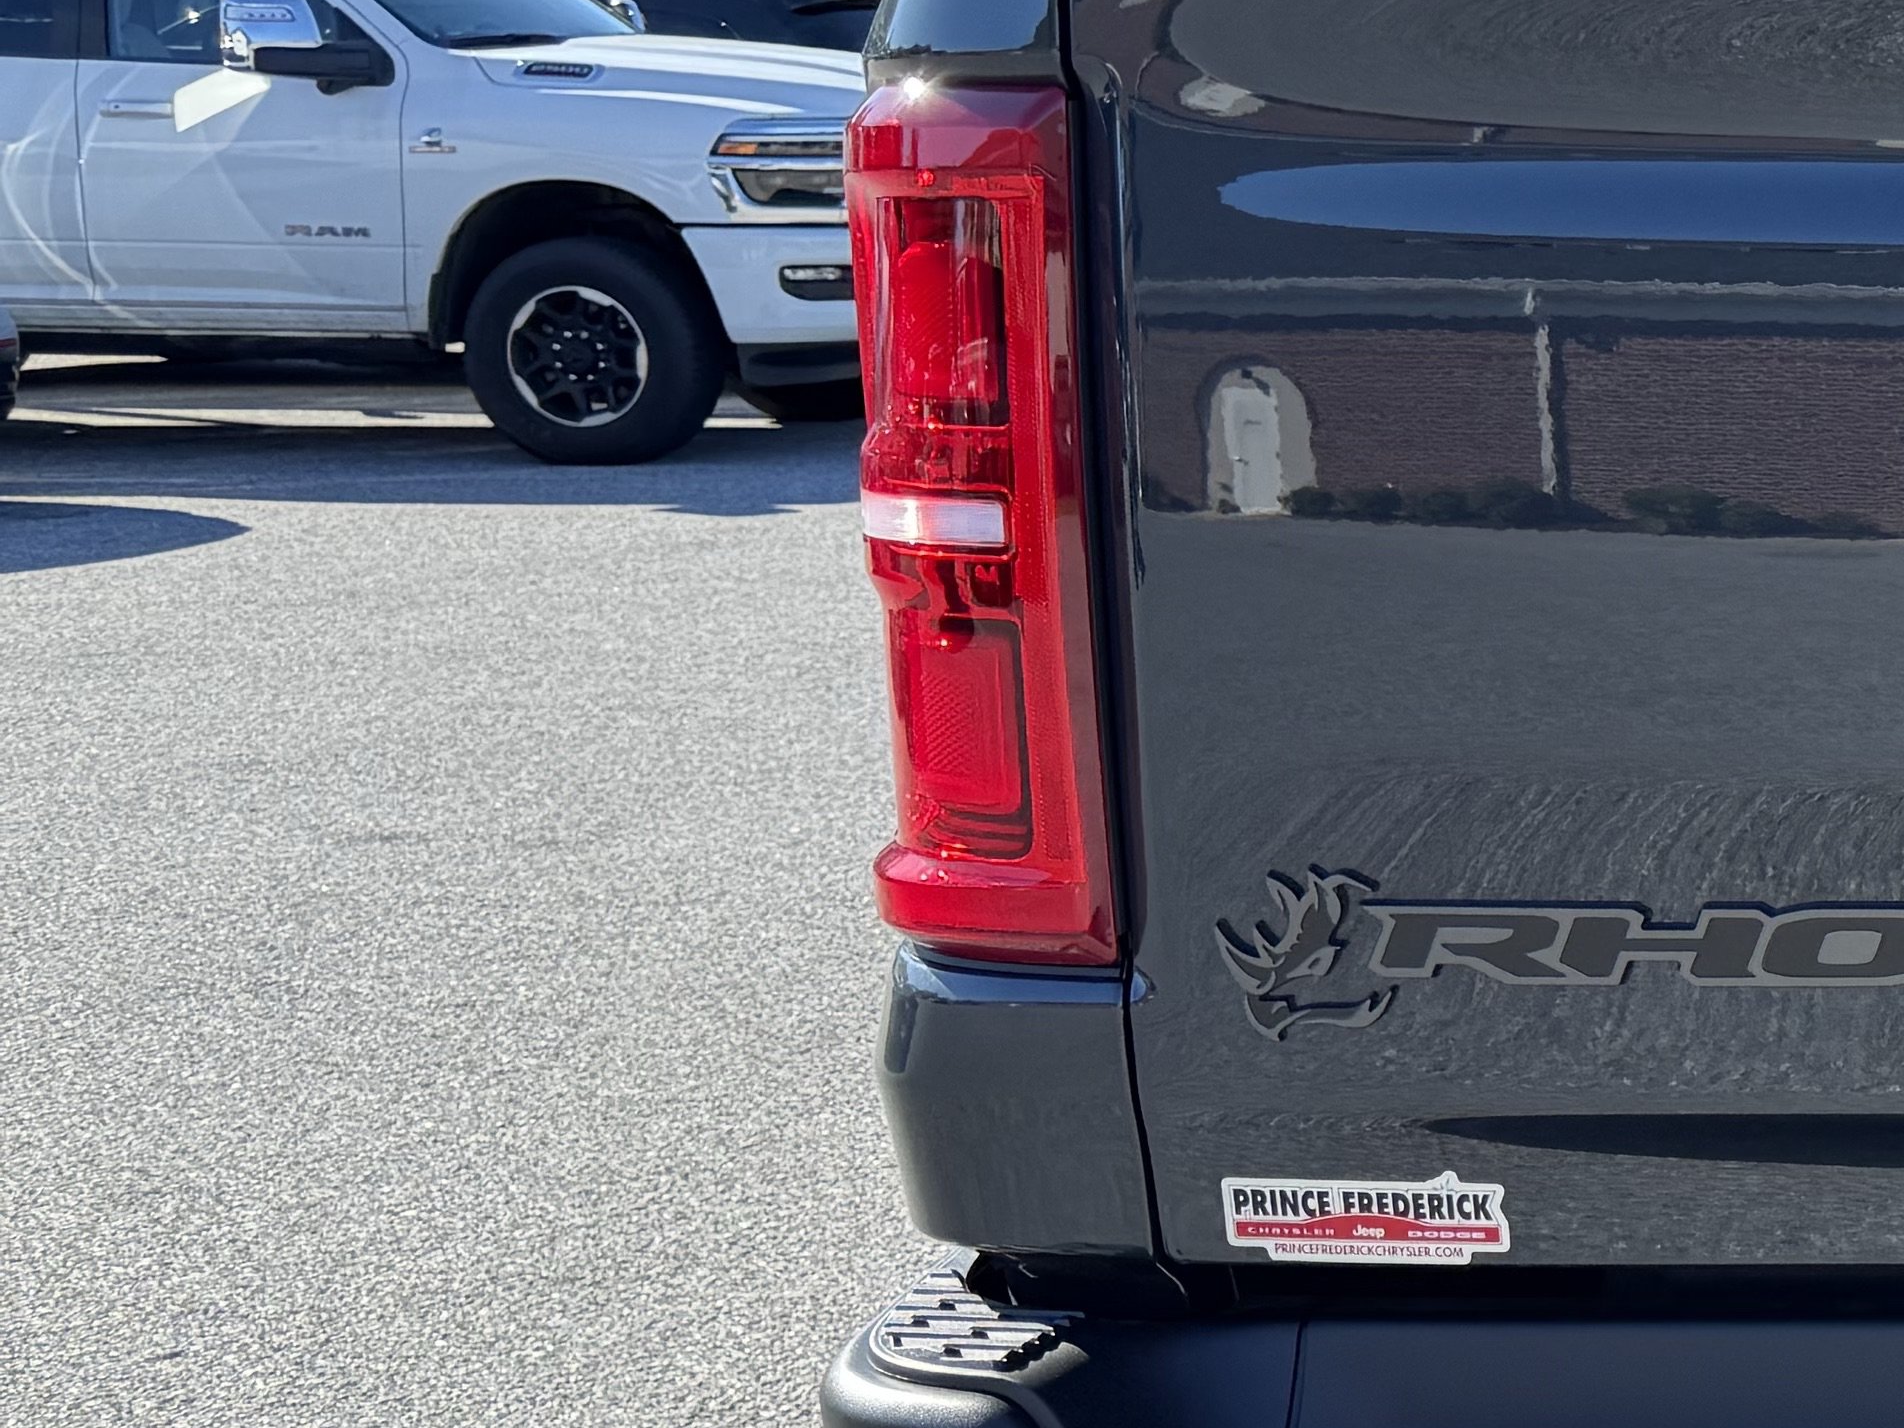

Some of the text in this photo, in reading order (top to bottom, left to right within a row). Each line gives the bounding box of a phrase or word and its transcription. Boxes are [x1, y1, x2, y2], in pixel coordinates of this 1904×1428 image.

[285, 224, 370, 237] RAM
[1232, 1187, 1491, 1221] PRINCE FREDERICK
[1247, 1224, 1486, 1239] CHRYSLER Jeep DODGE
[1274, 1242, 1464, 1258] PRINCEFREDERICKCHRYSLER.COM
